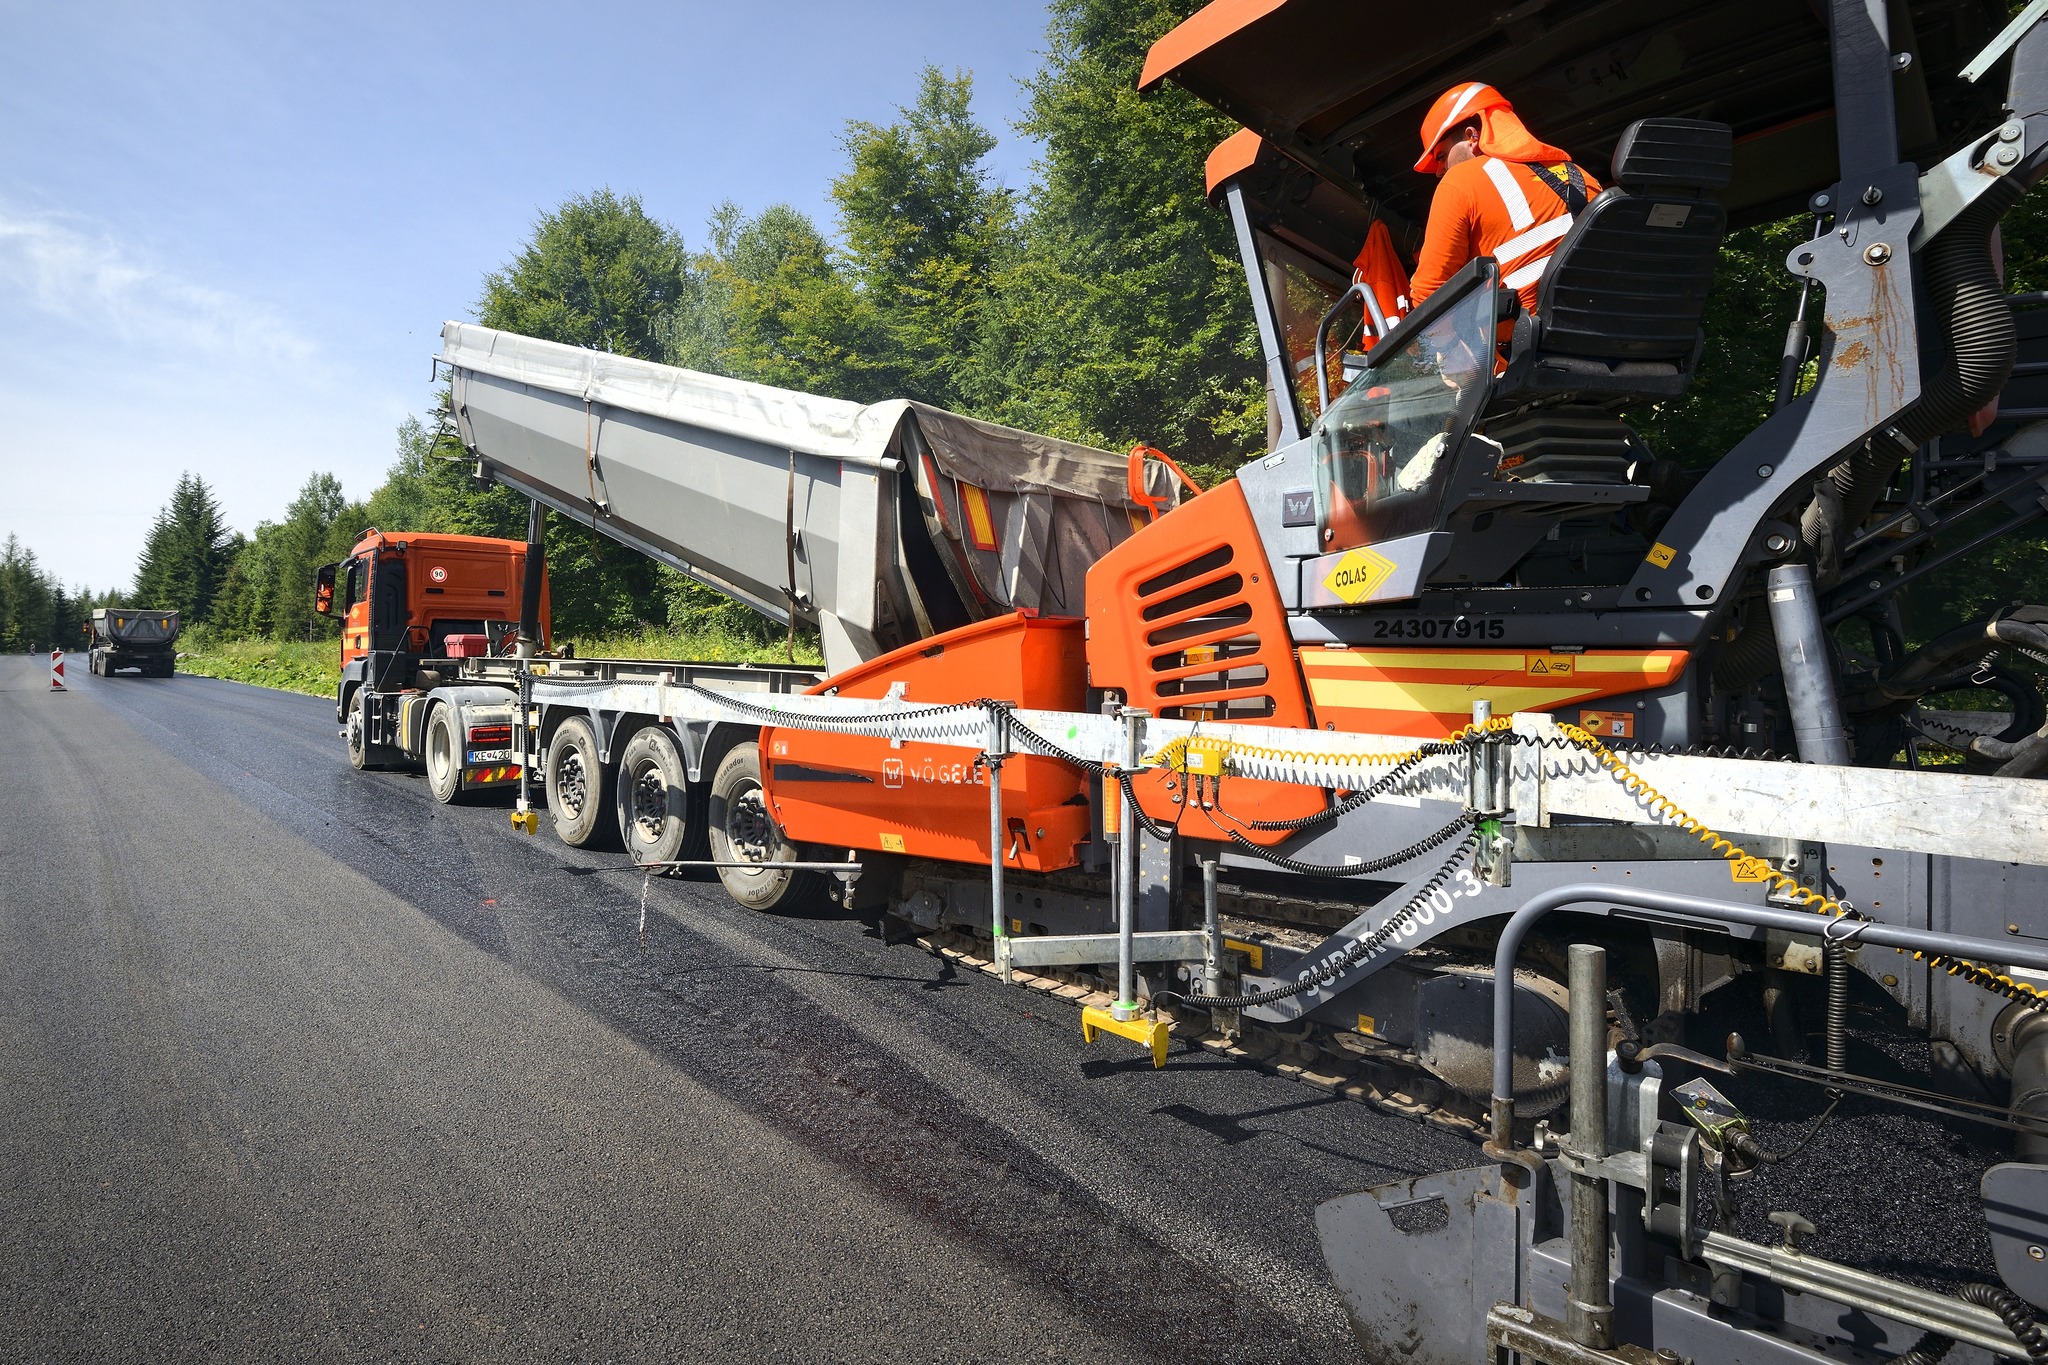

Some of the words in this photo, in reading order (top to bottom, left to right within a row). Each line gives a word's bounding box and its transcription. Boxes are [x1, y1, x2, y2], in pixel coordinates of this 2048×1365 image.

[434, 570, 443, 578] 90
[1335, 565, 1367, 588] COLAS
[1373, 619, 1505, 640] 24307915
[474, 751, 487, 762] KE
[718, 757, 744, 785] Matador
[910, 757, 984, 785] VÖGELE
[1298, 930, 1388, 998] SUPER
[1382, 867, 1493, 945] 1800-3
